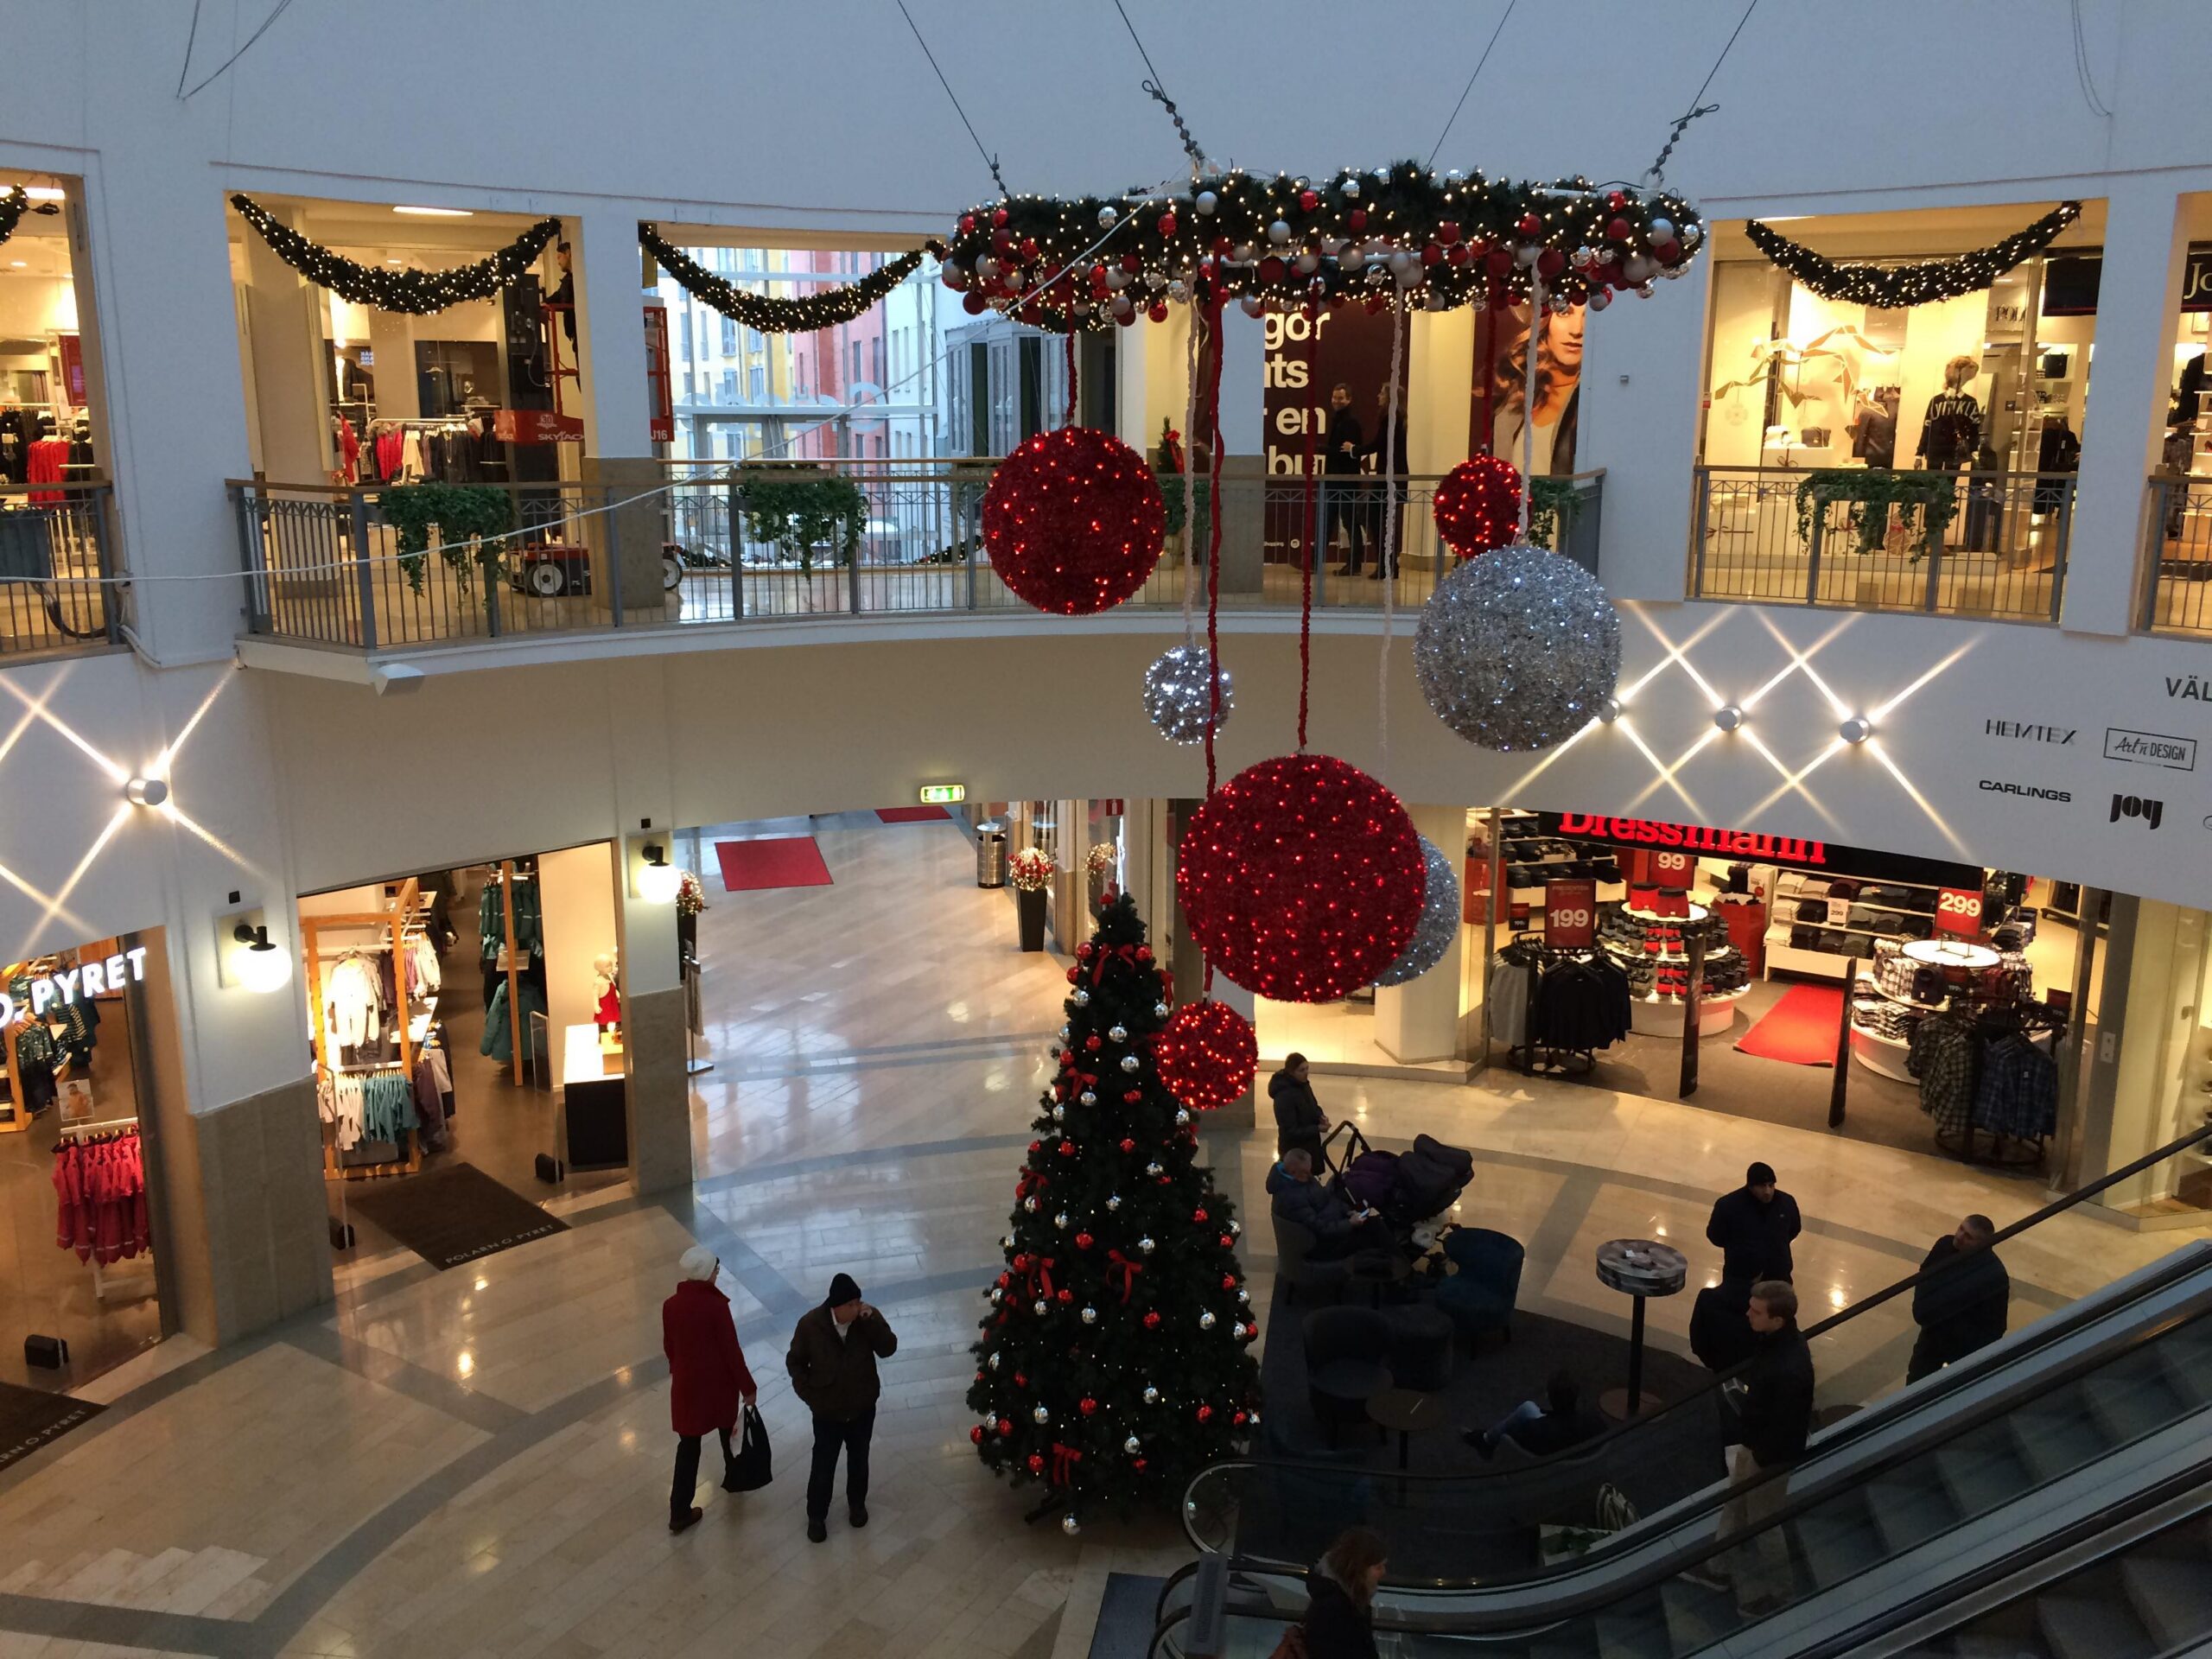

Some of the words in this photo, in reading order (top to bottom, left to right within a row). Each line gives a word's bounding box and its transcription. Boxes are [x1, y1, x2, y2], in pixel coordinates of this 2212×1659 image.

[537, 431, 585, 442] SKYJAC
[1986, 719, 2077, 745] HEMTEX
[2149, 742, 2186, 761] DESIGN
[1979, 780, 2071, 803] CARLINGS
[1559, 812, 1826, 863] Dressmann
[1657, 852, 1685, 870] 99
[1939, 892, 1981, 918] 299
[1549, 908, 1589, 928] 199
[31, 946, 146, 1014] PYRET
